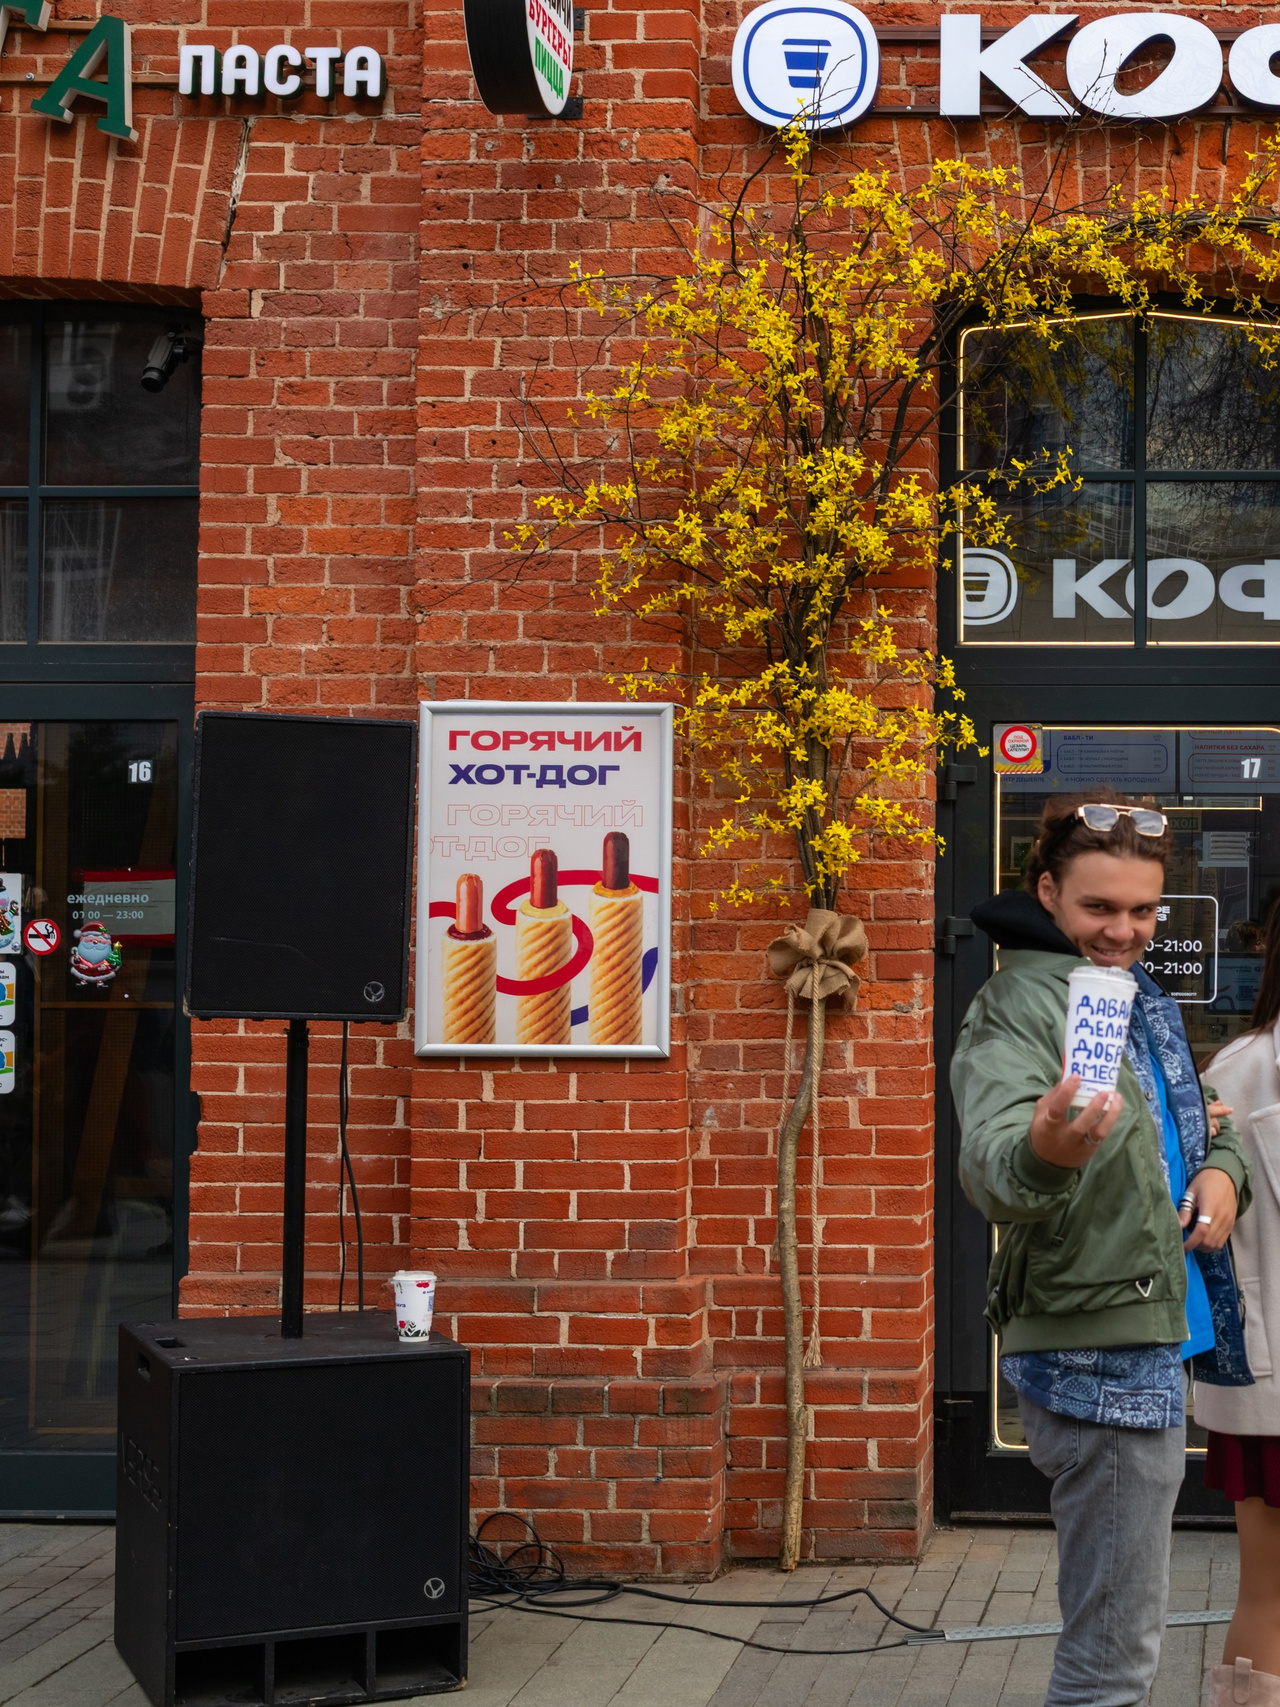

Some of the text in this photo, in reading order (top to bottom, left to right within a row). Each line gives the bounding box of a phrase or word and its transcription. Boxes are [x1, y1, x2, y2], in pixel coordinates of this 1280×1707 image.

[178, 44, 382, 98] ПАСТА
[535, 35, 564, 101] ПИЦЦА
[449, 726, 642, 752] ГОРЯЧИЙ
[128, 761, 152, 783] 16
[448, 764, 620, 788] ХОТ-ДОГ
[1241, 758, 1261, 779] 17
[447, 800, 643, 827] ГОРЯЧИЙ
[67, 893, 150, 906] ежедневно
[116, 910, 144, 920] 23:00
